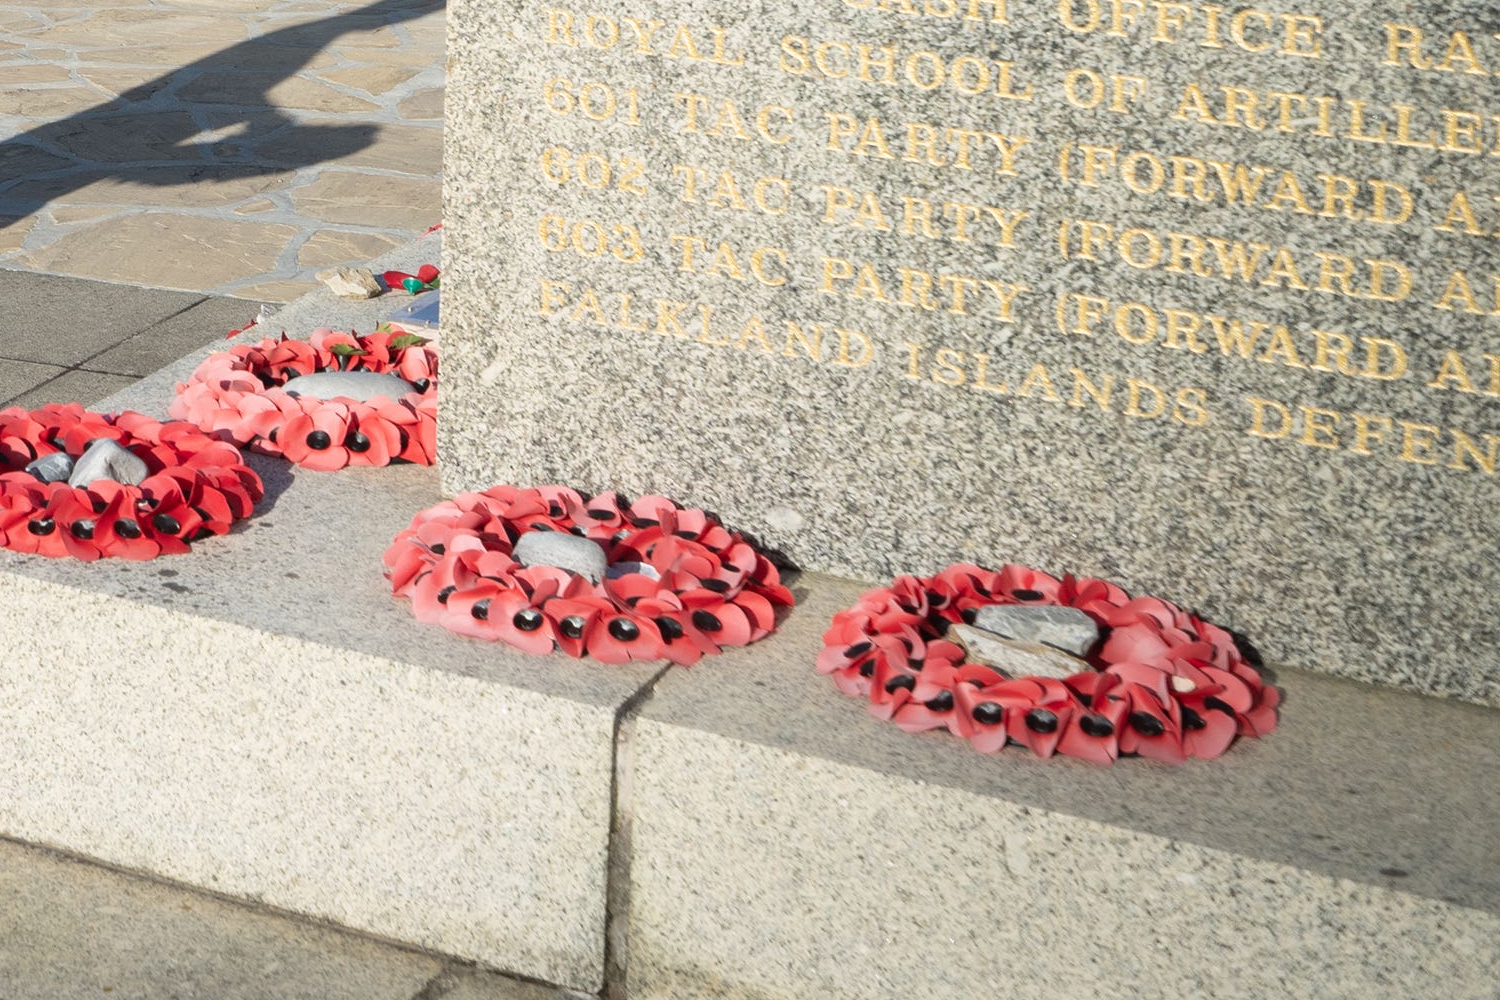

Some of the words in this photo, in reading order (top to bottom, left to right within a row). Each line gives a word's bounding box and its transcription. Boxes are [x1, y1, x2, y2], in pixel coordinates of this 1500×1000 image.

[544, 78, 638, 124] 601
[677, 93, 793, 143] TAC
[828, 113, 1029, 175] PARTY
[1059, 142, 1413, 224] (FORWARD
[546, 10, 743, 65] ROYAL
[781, 36, 1034, 100] SCHOOL
[1065, 69, 1146, 112] OF
[1175, 83, 1500, 154] ARTILLE
[542, 147, 647, 194] 602
[674, 165, 789, 214] TAC
[824, 185, 1028, 247] PARTY
[1058, 220, 1412, 300] (FORWARD
[539, 216, 644, 262] 603
[672, 234, 786, 285] TAC
[822, 258, 1027, 320] PARTY
[1057, 293, 1407, 378] (FORWARD
[539, 279, 876, 367] FALKLAND
[909, 344, 1208, 425] ISLANDS
